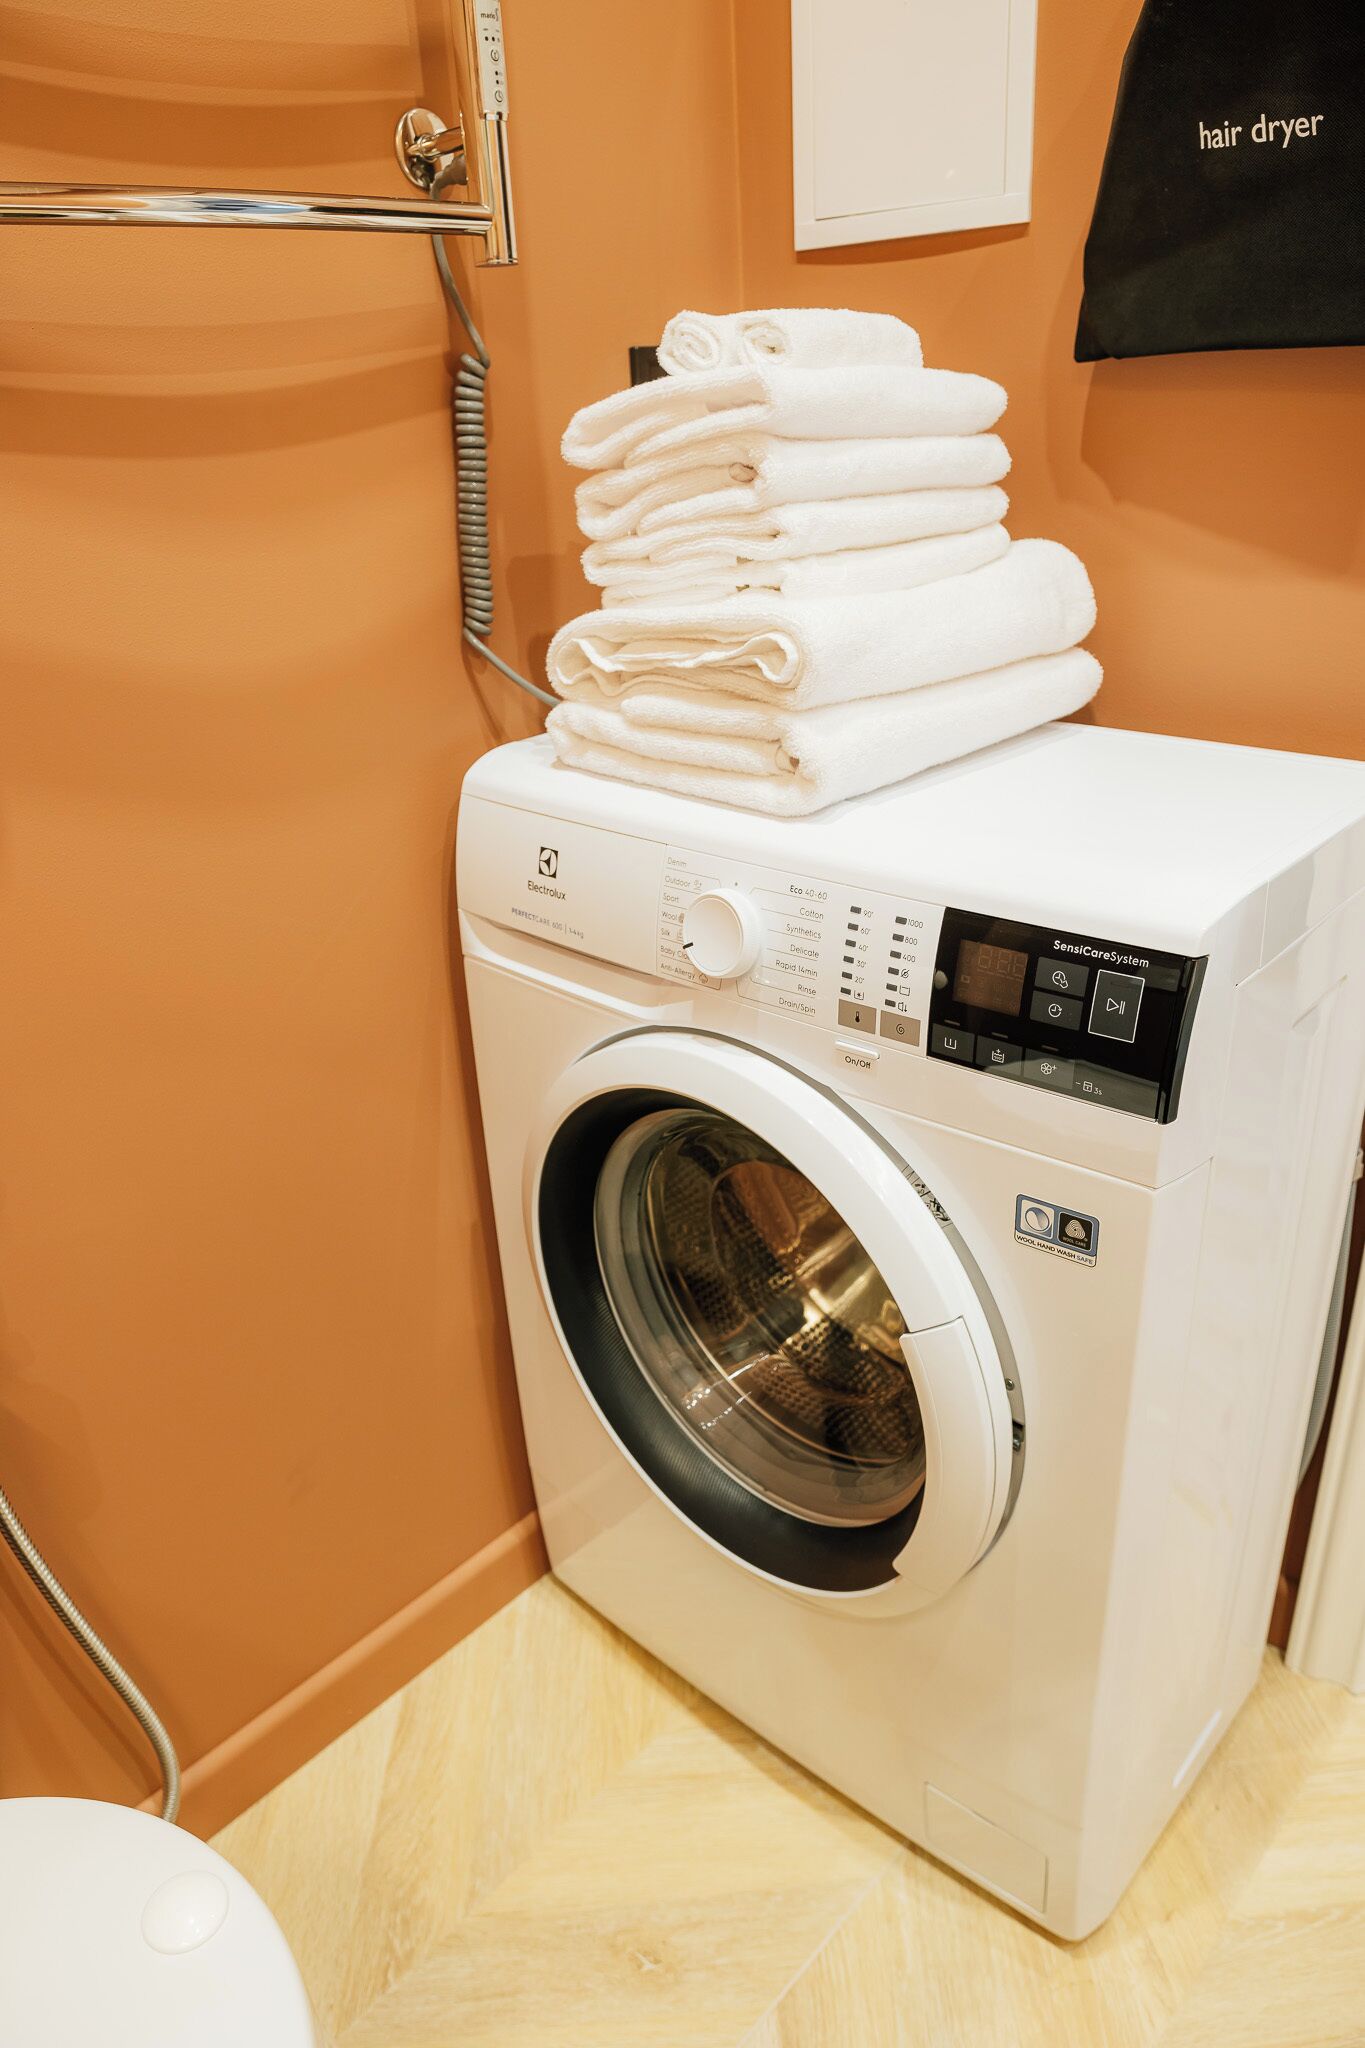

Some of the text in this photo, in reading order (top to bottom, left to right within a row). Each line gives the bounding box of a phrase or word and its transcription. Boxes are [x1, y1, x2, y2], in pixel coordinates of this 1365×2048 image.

[1199, 113, 1324, 149] hair dryer
[667, 857, 687, 868] Denim
[664, 875, 691, 888] Outdoor
[527, 880, 566, 901] Electrolux
[789, 884, 828, 900] Eco 40-60
[662, 892, 679, 904] Sport
[661, 910, 678, 921] Wool
[799, 907, 824, 920] Cotton
[907, 917, 924, 929] 1000
[660, 927, 670, 937] Silk
[786, 923, 822, 940] Synthetics
[904, 936, 918, 946] 800
[660, 945, 675, 957] Baby
[789, 943, 820, 959] Delicate
[1053, 939, 1150, 968] SensiCareSystem
[902, 953, 916, 963] 400
[660, 962, 696, 980] Anti-Allergy
[775, 959, 818, 978] Rapid 14min
[797, 983, 817, 996] Rinse
[778, 997, 816, 1015] Drain/Spin
[844, 1055, 871, 1069] On/Off
[1016, 1234, 1093, 1265] WOOL HAND WASH SAFE
